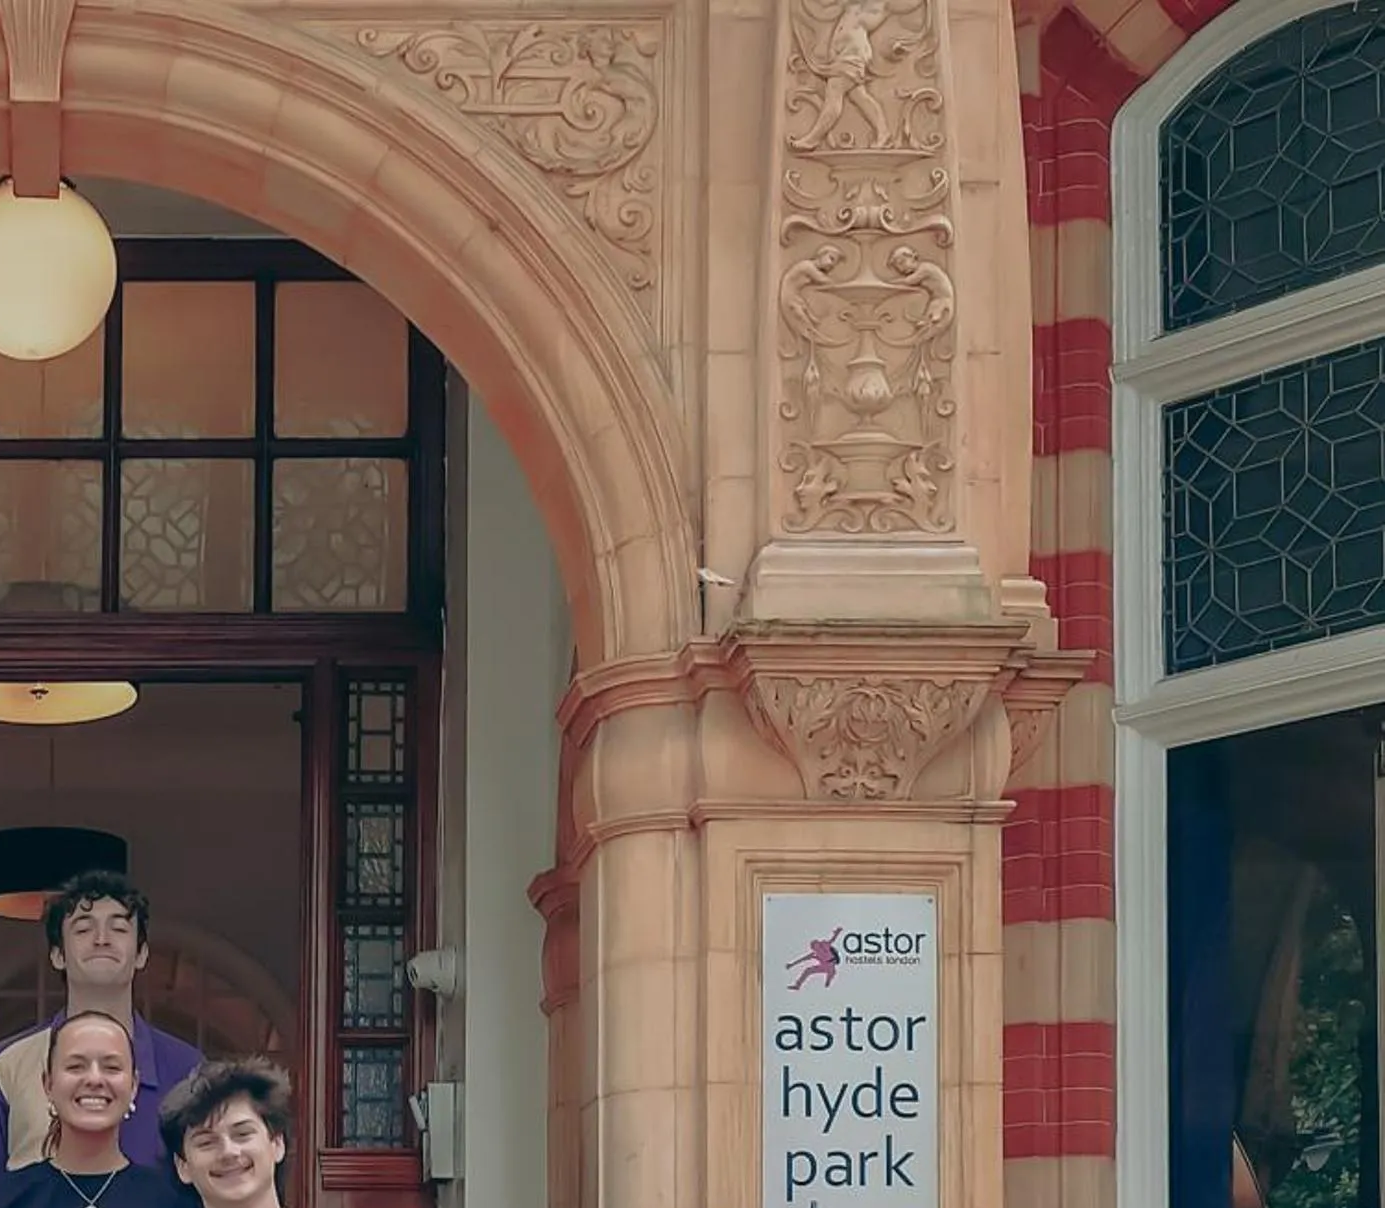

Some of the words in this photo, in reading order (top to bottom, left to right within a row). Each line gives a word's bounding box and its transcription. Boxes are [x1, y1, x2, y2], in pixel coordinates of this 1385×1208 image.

[843, 927, 926, 954] astor
[845, 955, 883, 965] hostels
[886, 955, 921, 965] london
[775, 1007, 926, 1051] astor
[782, 1065, 919, 1134] hyde
[786, 1134, 915, 1202] park
